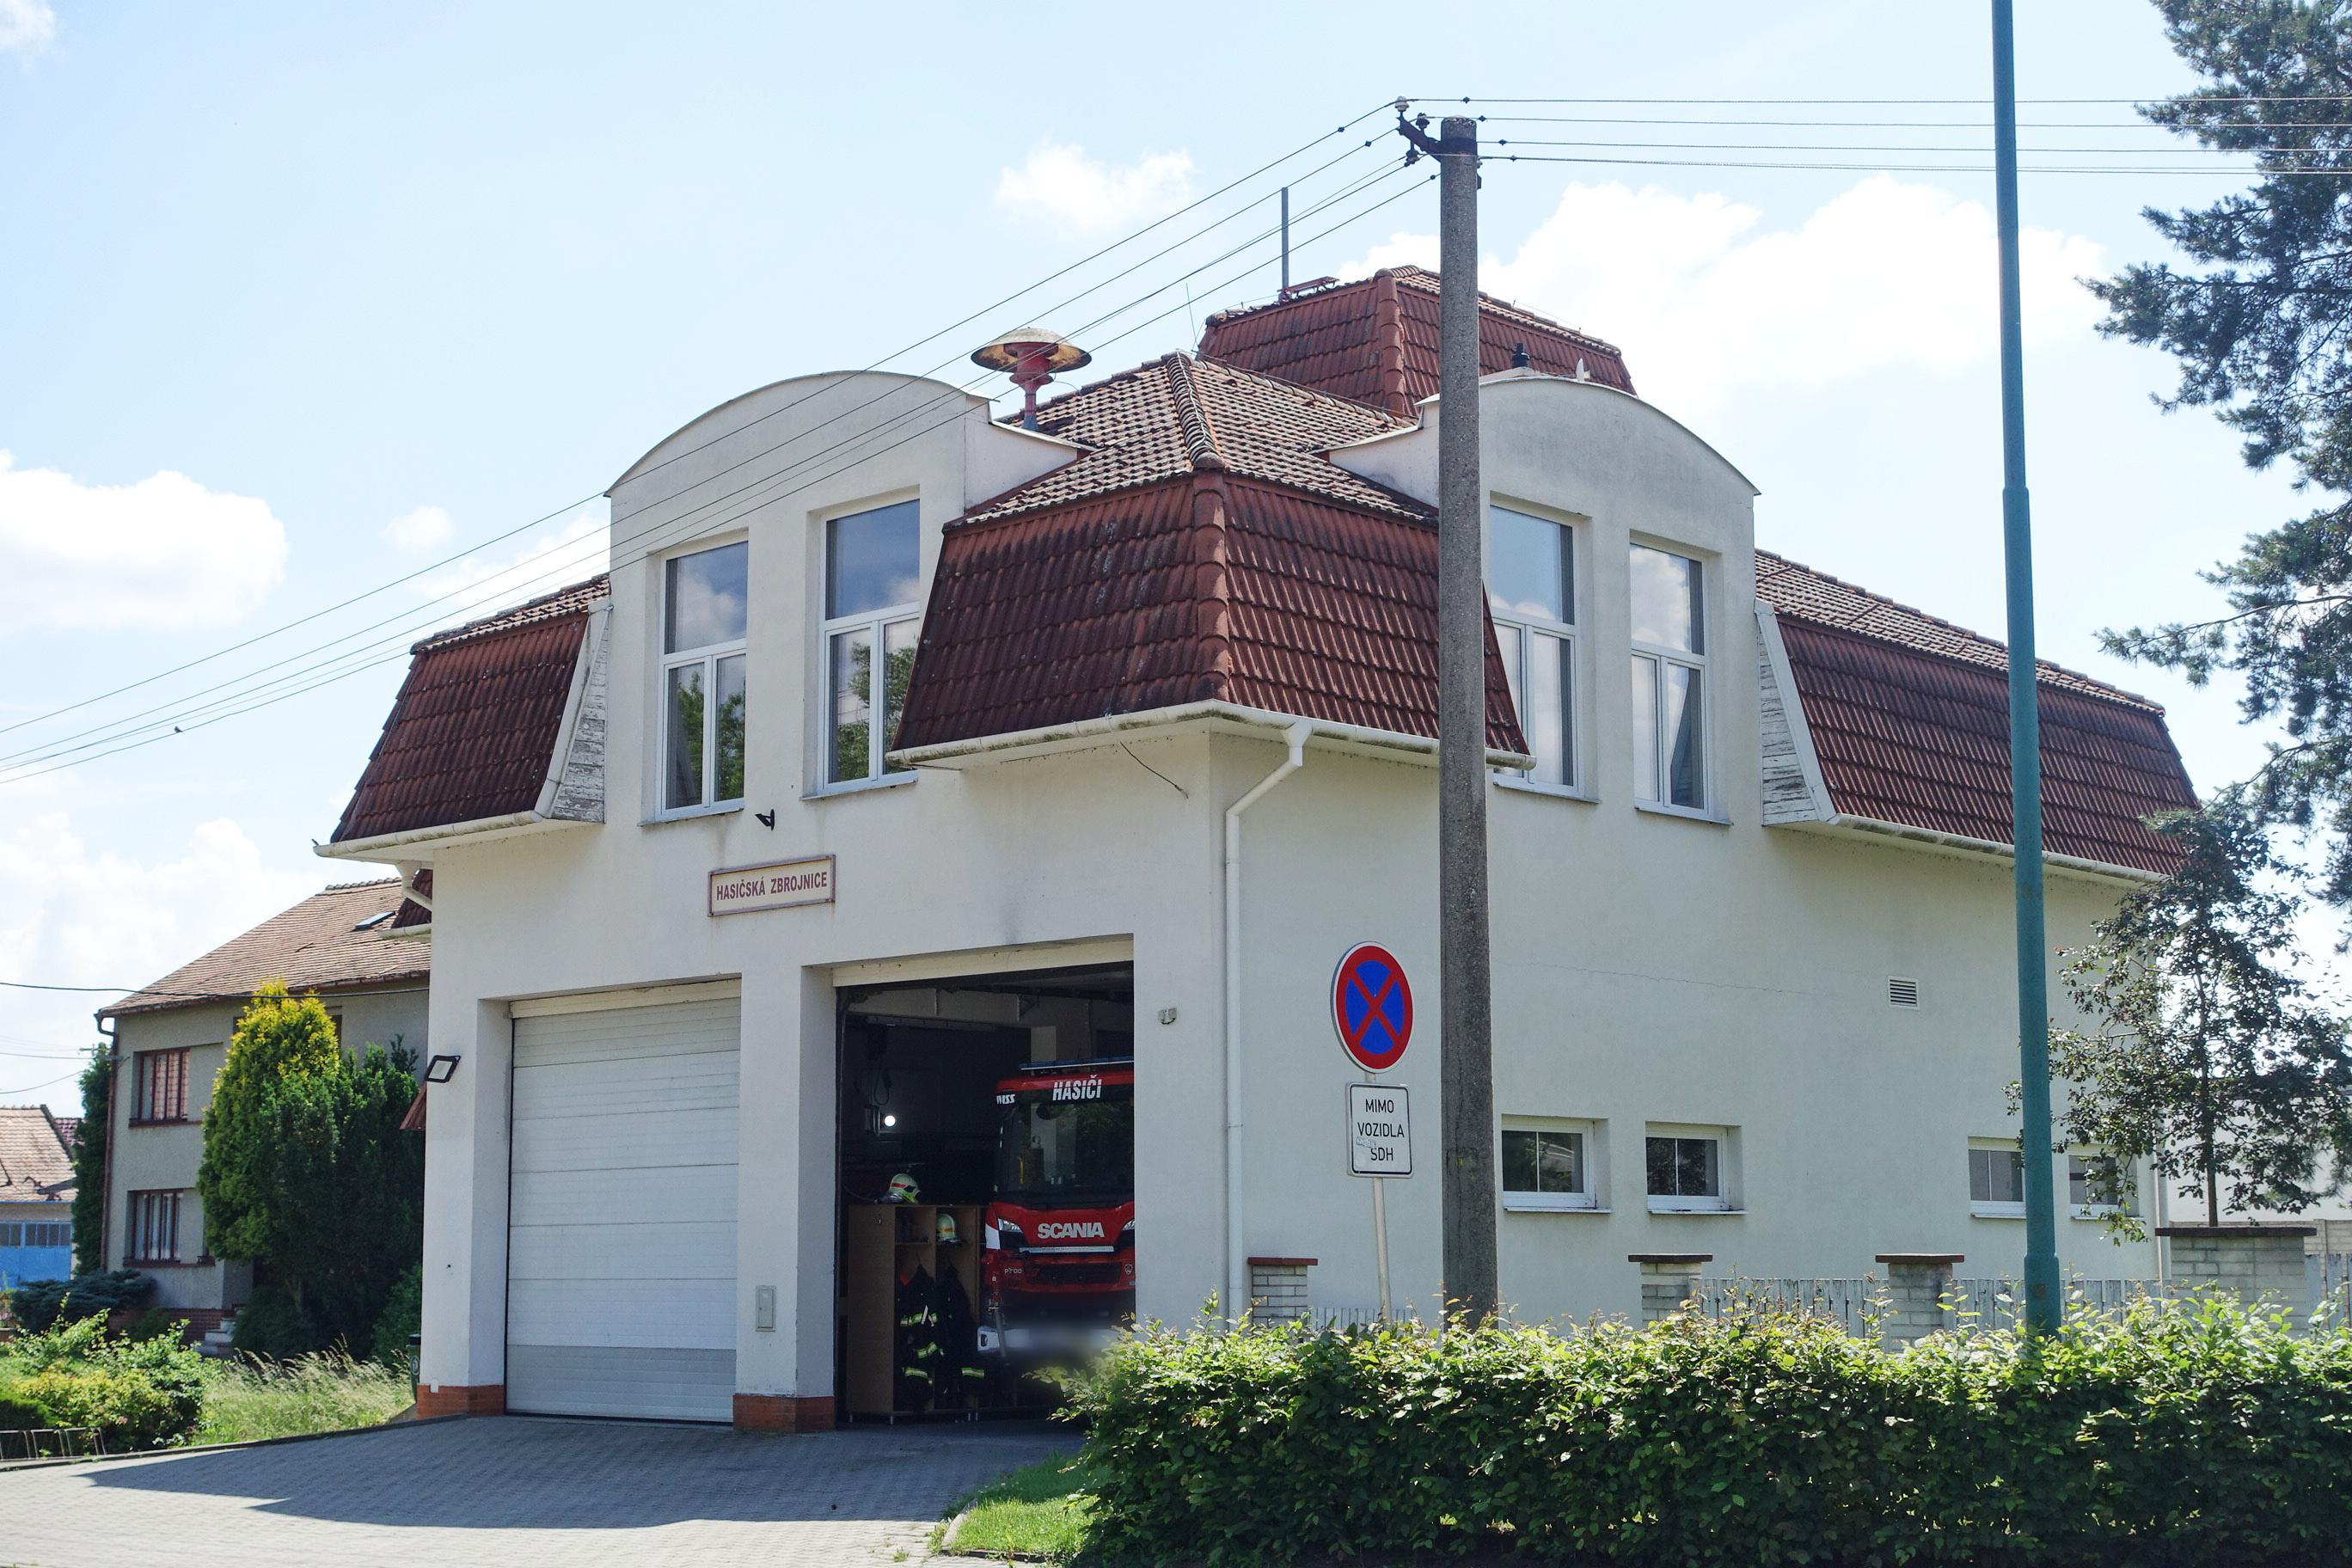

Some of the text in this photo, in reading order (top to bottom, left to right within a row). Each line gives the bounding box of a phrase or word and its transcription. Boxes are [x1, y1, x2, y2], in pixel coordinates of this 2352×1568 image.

[716, 871, 827, 901] HASIČSKÁ ZBROJNICE
[1052, 1075, 1103, 1101] HASIČI
[1365, 1099, 1394, 1113] MIMO
[1357, 1122, 1405, 1138] VOZIDLA
[1370, 1147, 1393, 1161] SDH
[1037, 1222, 1106, 1239] SCANIA
